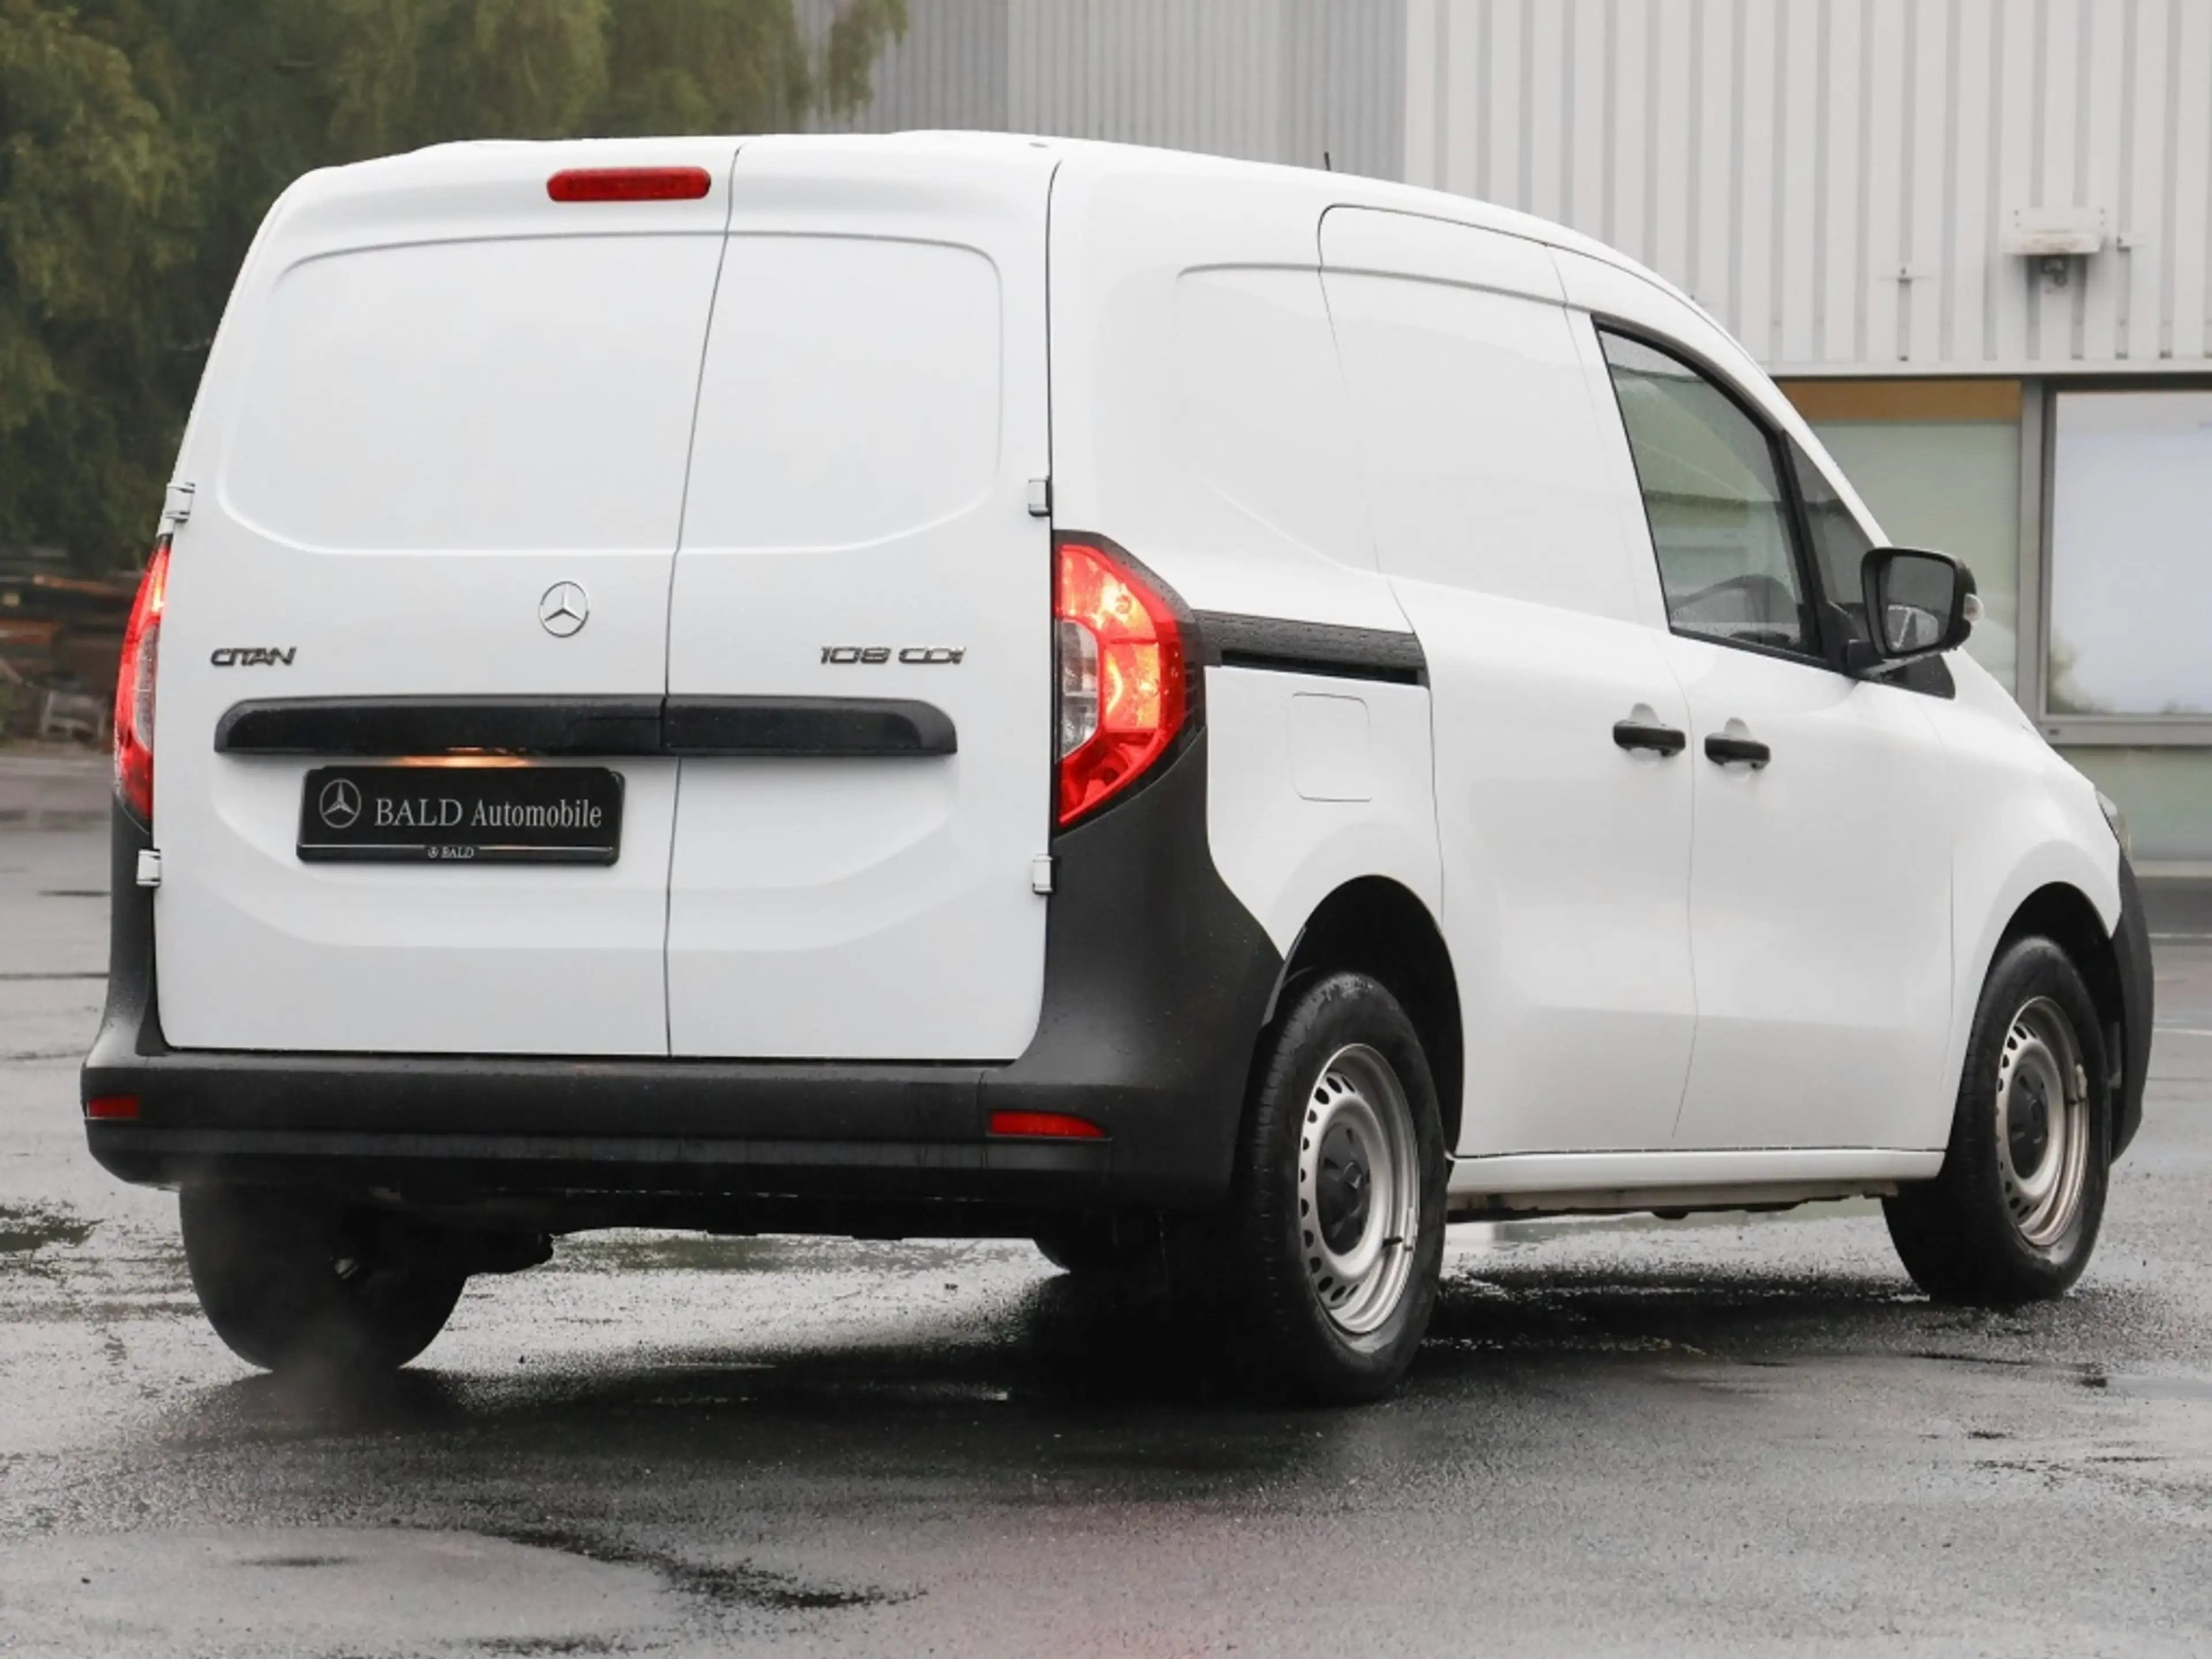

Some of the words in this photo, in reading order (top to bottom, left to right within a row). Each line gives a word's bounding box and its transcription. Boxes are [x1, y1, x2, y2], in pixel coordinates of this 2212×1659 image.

[211, 647, 297, 666] CITAN
[820, 646, 891, 664] 108
[898, 645, 966, 664] CDI
[374, 798, 462, 826] BALD
[471, 800, 602, 828] Automobile
[441, 846, 474, 858] BALD
